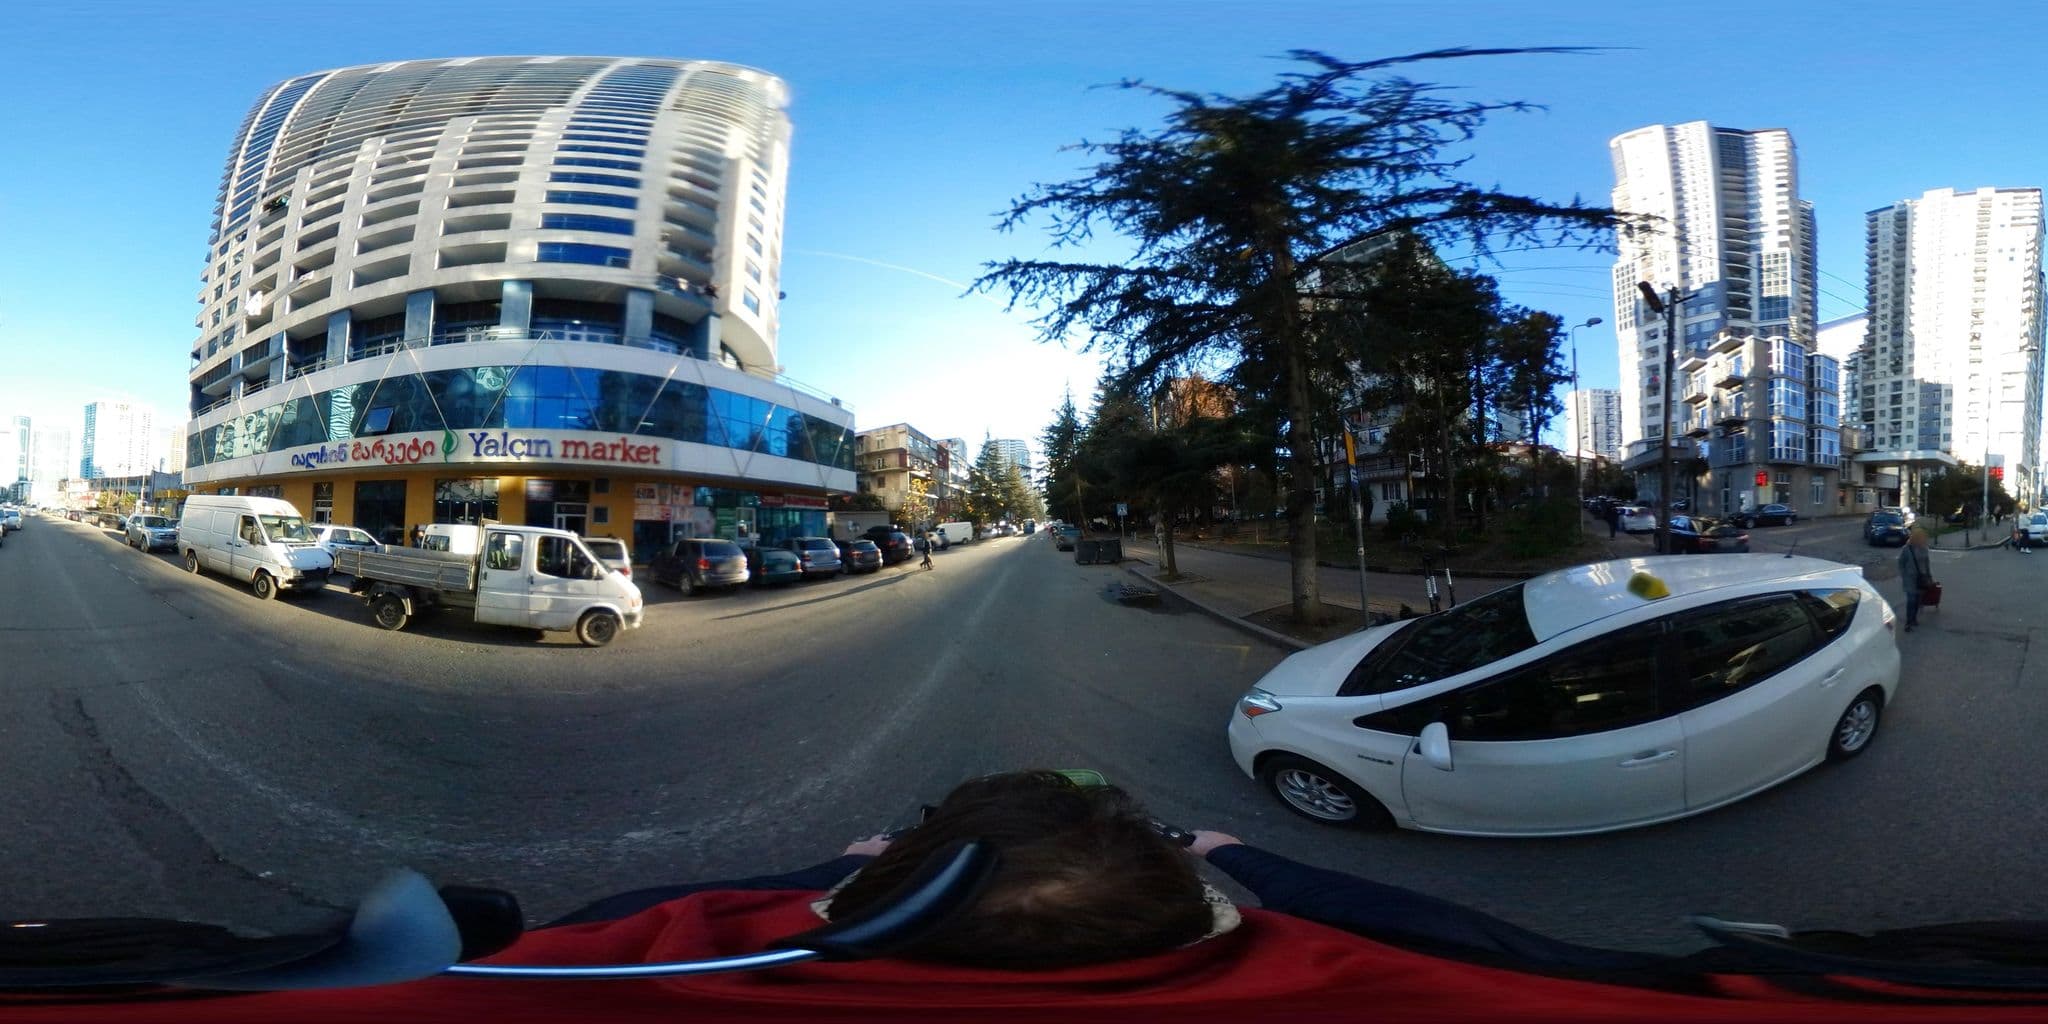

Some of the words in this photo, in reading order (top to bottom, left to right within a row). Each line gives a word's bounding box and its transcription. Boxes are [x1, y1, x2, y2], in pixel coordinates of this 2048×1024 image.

[351, 437, 436, 465] მარკეტი
[468, 431, 553, 460] Yalçın
[560, 437, 661, 464] market
